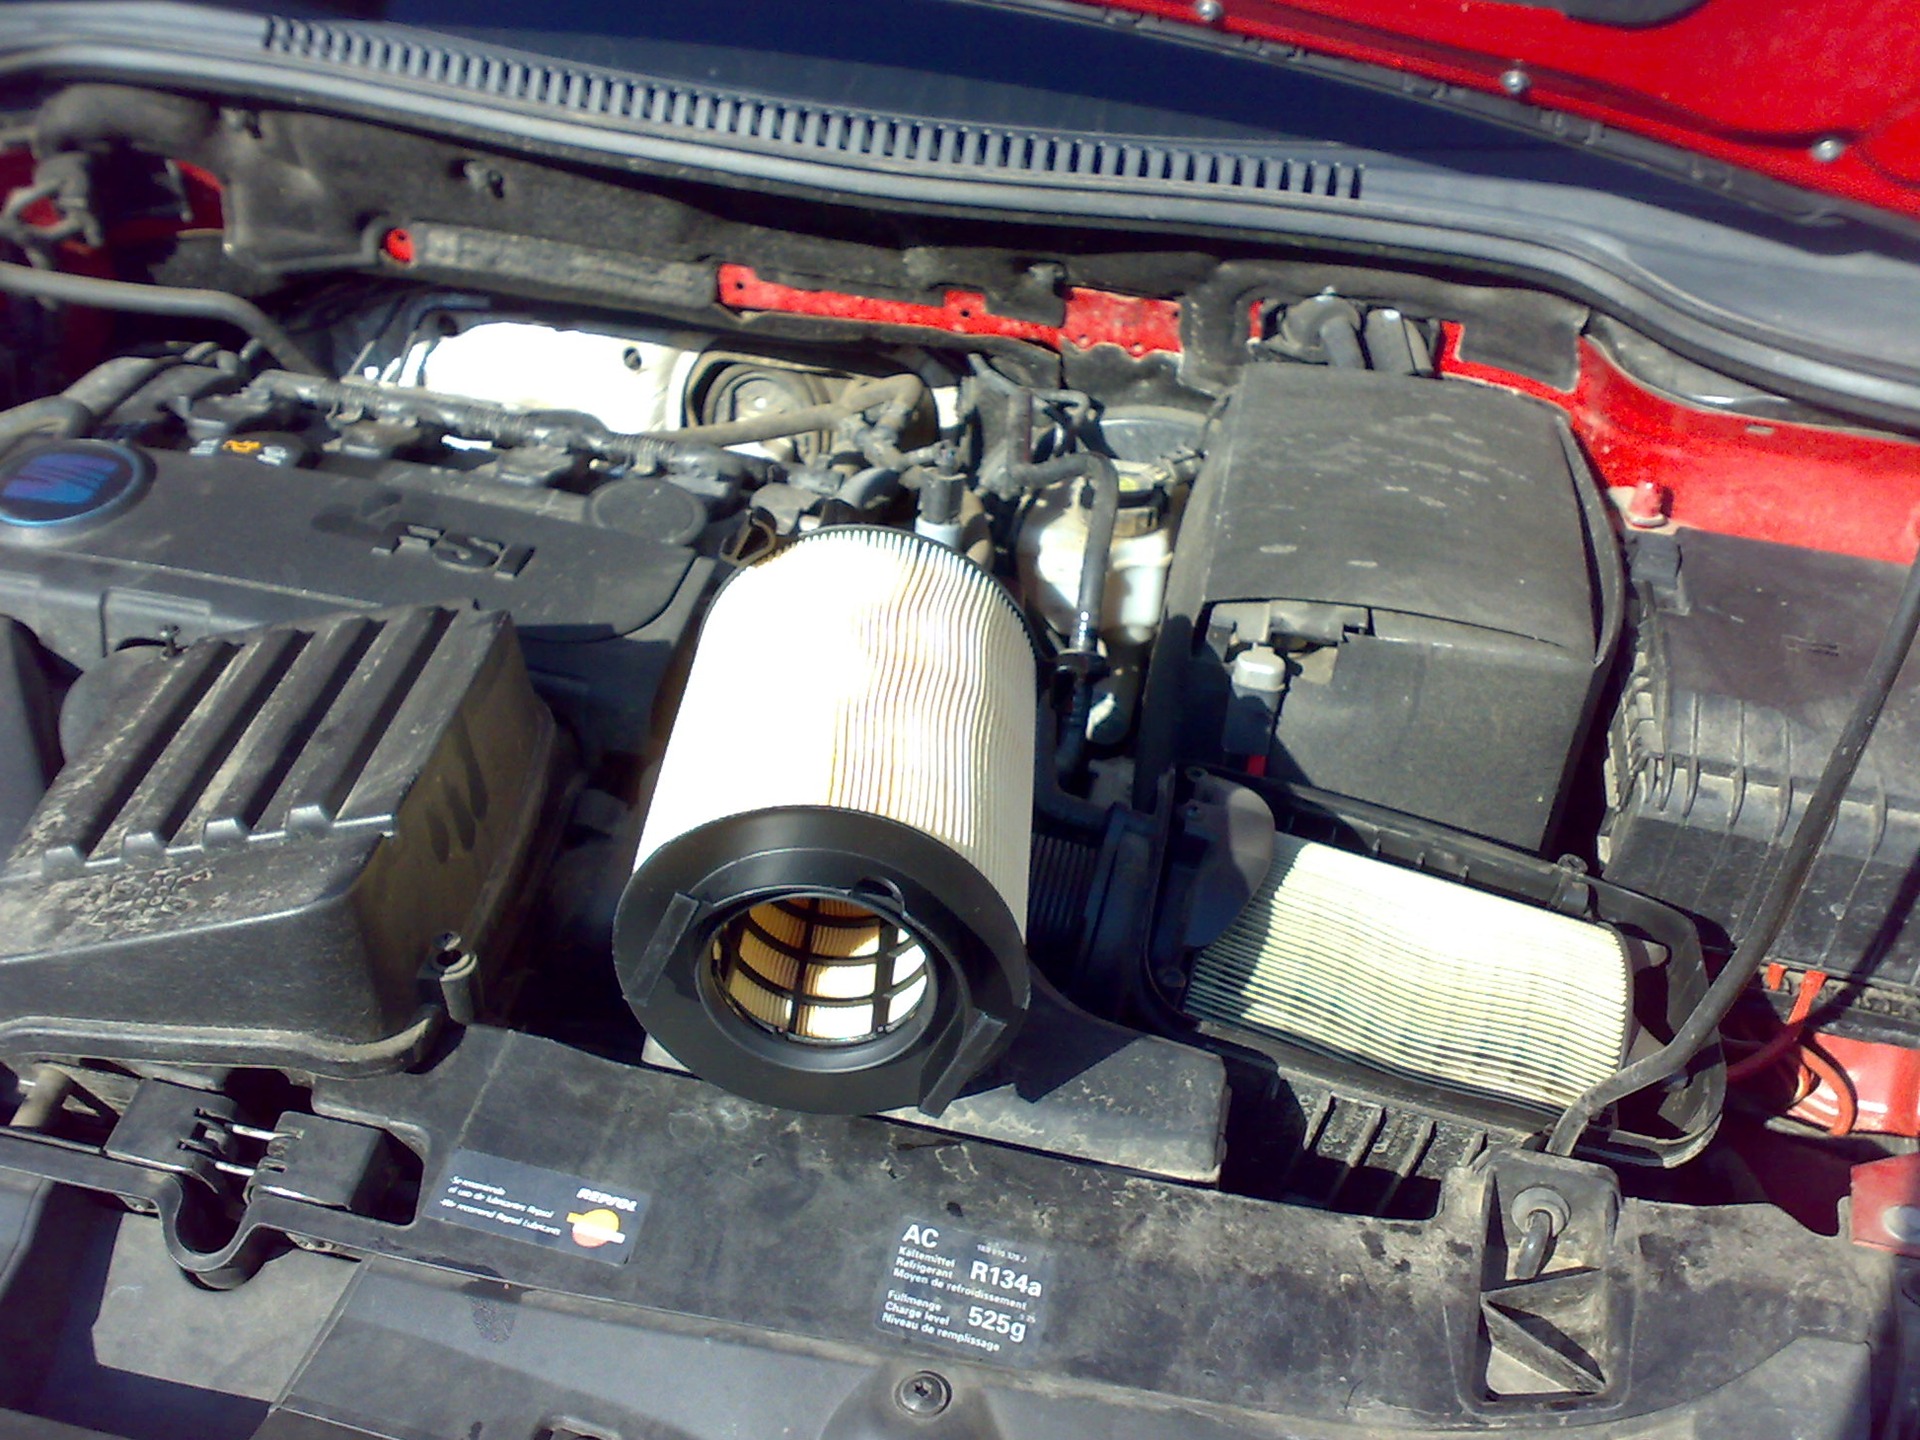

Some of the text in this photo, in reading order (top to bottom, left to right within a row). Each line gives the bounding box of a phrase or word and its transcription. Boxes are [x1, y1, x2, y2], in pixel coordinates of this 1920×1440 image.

[901, 1224, 940, 1249] AC
[895, 1256, 953, 1279] Refrigerant
[970, 1260, 1043, 1298] R134a
[893, 1267, 1027, 1311] Moyen de refroidissement
[881, 1312, 1000, 1352] Niveau de remplissage
[885, 1301, 950, 1326] Charge level
[968, 1305, 1027, 1343] 525g
